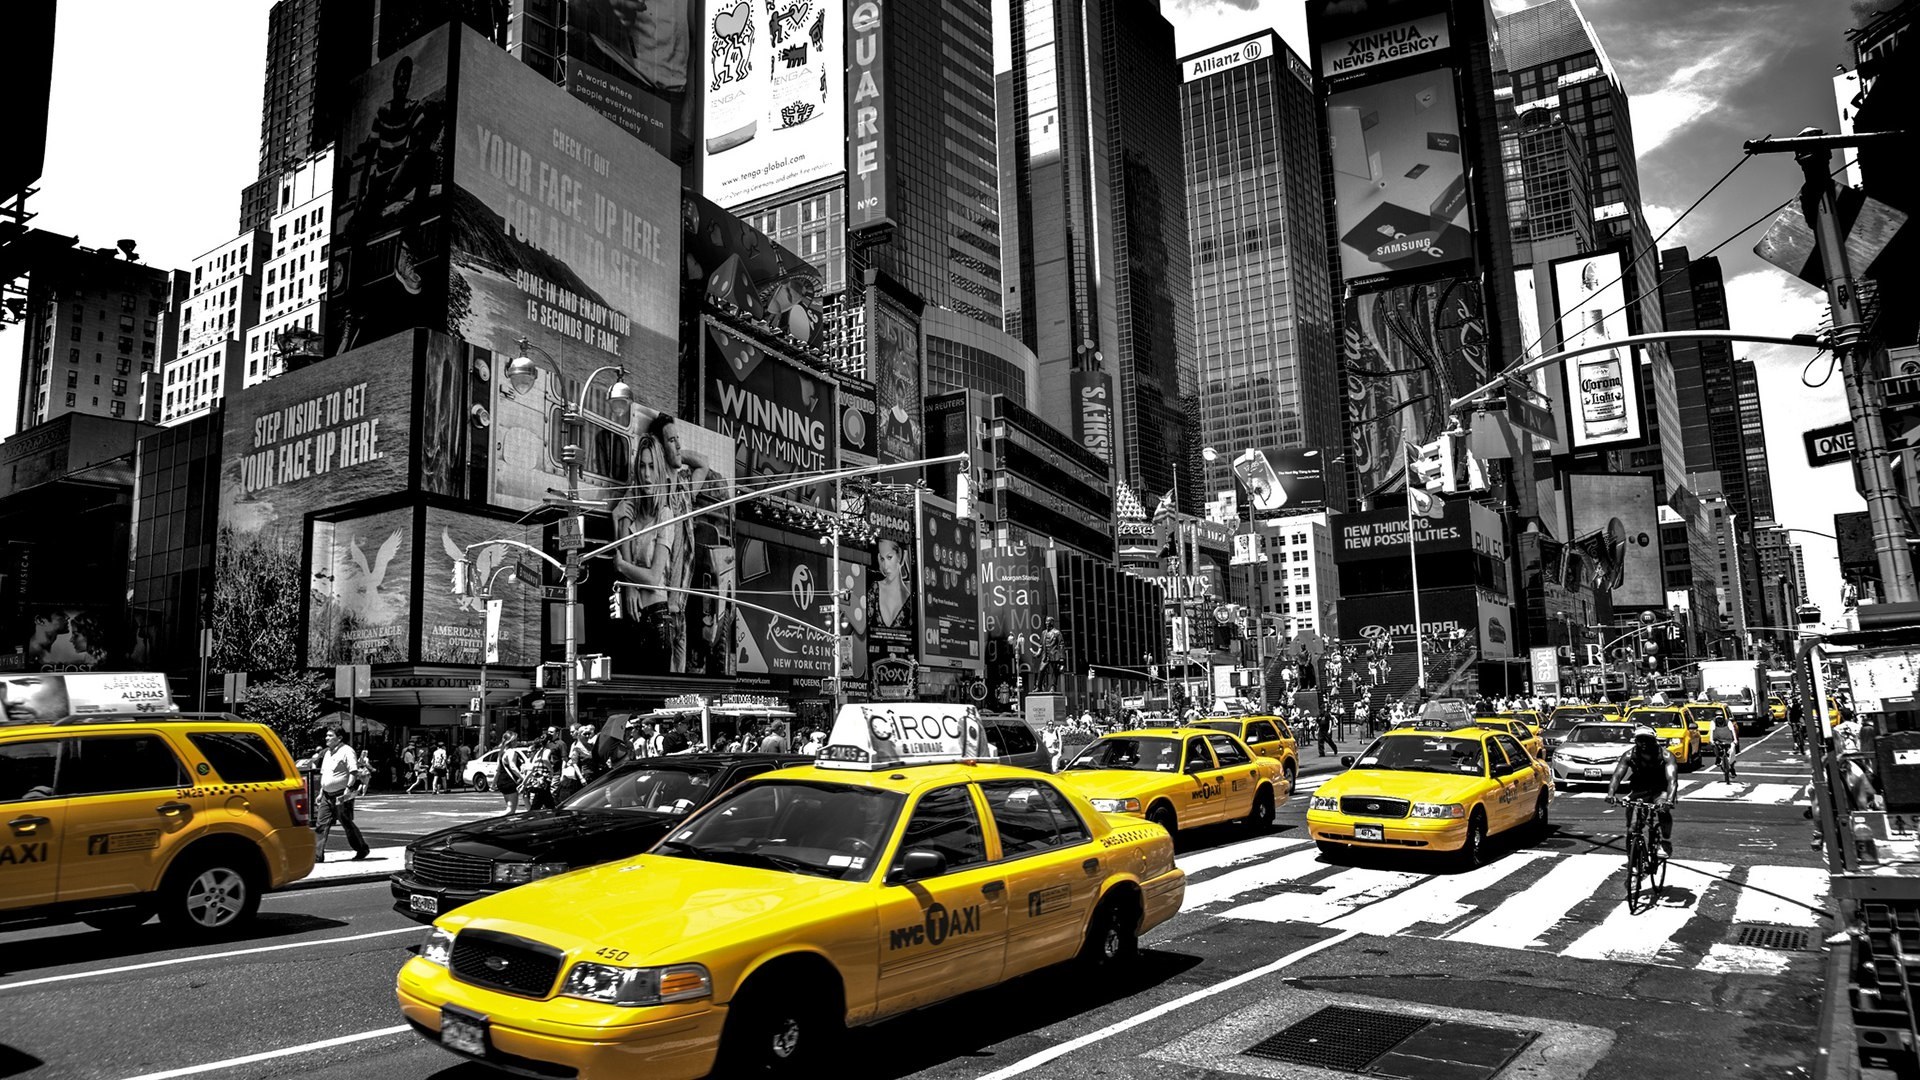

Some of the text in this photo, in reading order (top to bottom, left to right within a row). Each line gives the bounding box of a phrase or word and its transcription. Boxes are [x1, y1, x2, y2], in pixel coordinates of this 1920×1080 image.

[1347, 25, 1421, 56] XINHUA
[1333, 52, 1375, 72] NEWS
[1378, 35, 1439, 62] AGENCY
[1193, 52, 1240, 76] Allianz
[577, 69, 632, 100] A world where
[576, 84, 603, 101] people
[605, 96, 648, 122] everywhere
[650, 118, 664, 129] can
[602, 110, 641, 133] and freely
[552, 128, 610, 178] CHECK IT OUT
[477, 124, 666, 267] YOUR FACE. UP HERE.
[857, 197, 878, 211] NYC
[504, 193, 541, 251] FOR
[582, 232, 605, 280] TO
[1377, 238, 1431, 256] SAMSUNG
[516, 268, 631, 337] COME IN AND ENJOY YOUR
[527, 299, 622, 357] 15 SECONDS OF FAME.
[1582, 377, 1622, 394] Corona
[1591, 392, 1615, 405] Light
[254, 382, 368, 448] STEP INSIDE TO GET
[716, 378, 825, 451] WINNING
[716, 415, 734, 439] IN
[736, 424, 773, 458] ANY
[775, 437, 826, 474] MINUTE
[1820, 434, 1857, 454] ONE
[240, 418, 384, 493] YOUR FACE UP HERE.
[870, 512, 910, 532] CHICAGO
[1344, 518, 1432, 538] NEW THINKNG.
[1345, 537, 1372, 550] NEW
[342, 625, 402, 641] AMERICAN EAGLE
[432, 626, 481, 638] AMERICAN
[1389, 620, 1458, 636] HYUNDAI
[449, 638, 483, 647] OUTFITT
[40, 663, 94, 673] GHOST
[773, 657, 832, 671] NEW YORK CITY
[391, 678, 434, 688] EAGLE
[437, 678, 509, 689] OUTFITERS
[792, 678, 799, 686] IN
[121, 690, 164, 699] ALPHAS
[831, 746, 857, 760] 2M35
[1191, 789, 1203, 800] NYC
[889, 903, 981, 950] NYC TAXI
[595, 947, 630, 962] 450
